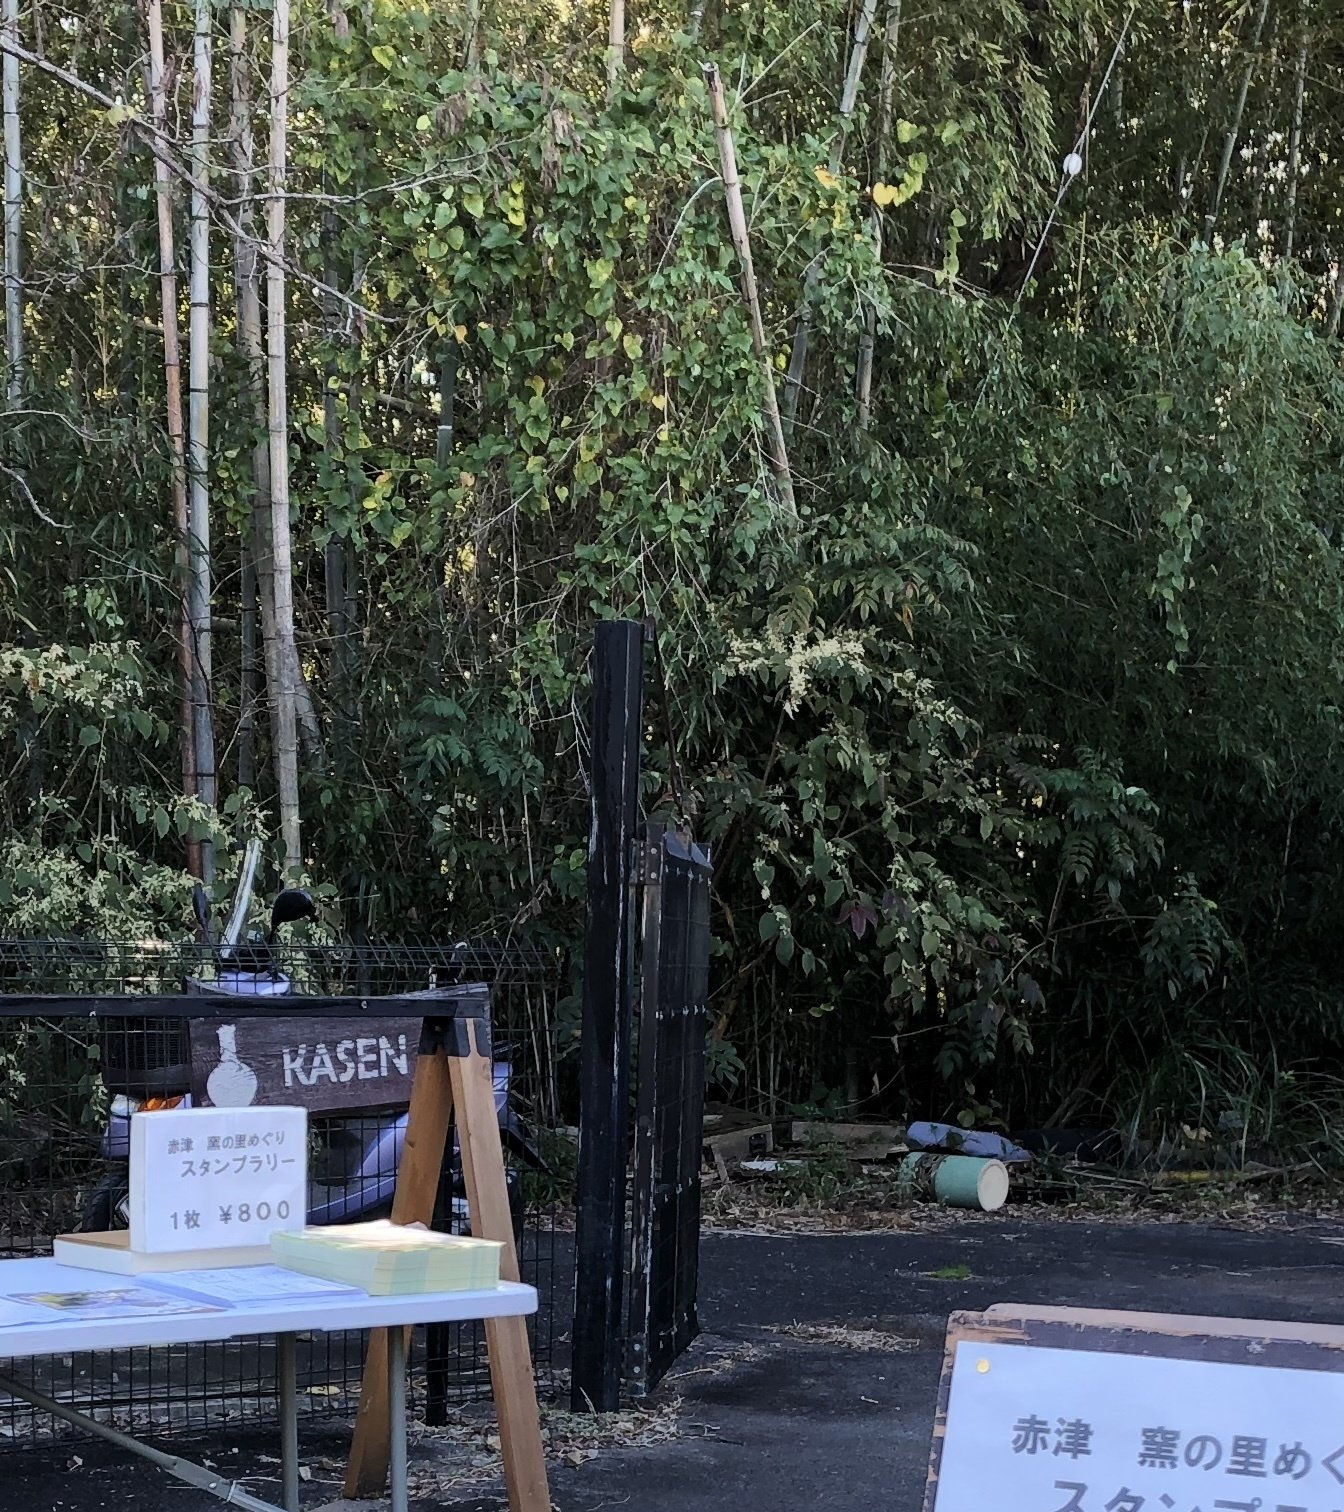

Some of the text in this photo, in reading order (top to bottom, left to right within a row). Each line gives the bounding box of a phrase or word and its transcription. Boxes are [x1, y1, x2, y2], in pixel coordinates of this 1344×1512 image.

[282, 1034, 409, 1088] KASEN
[167, 1131, 286, 1154] 赤津 窯の里めぐり
[181, 1152, 296, 1178] スタンプラリー
[170, 1200, 290, 1230] 1枚 ¥800
[1010, 1414, 1094, 1459] 赤津
